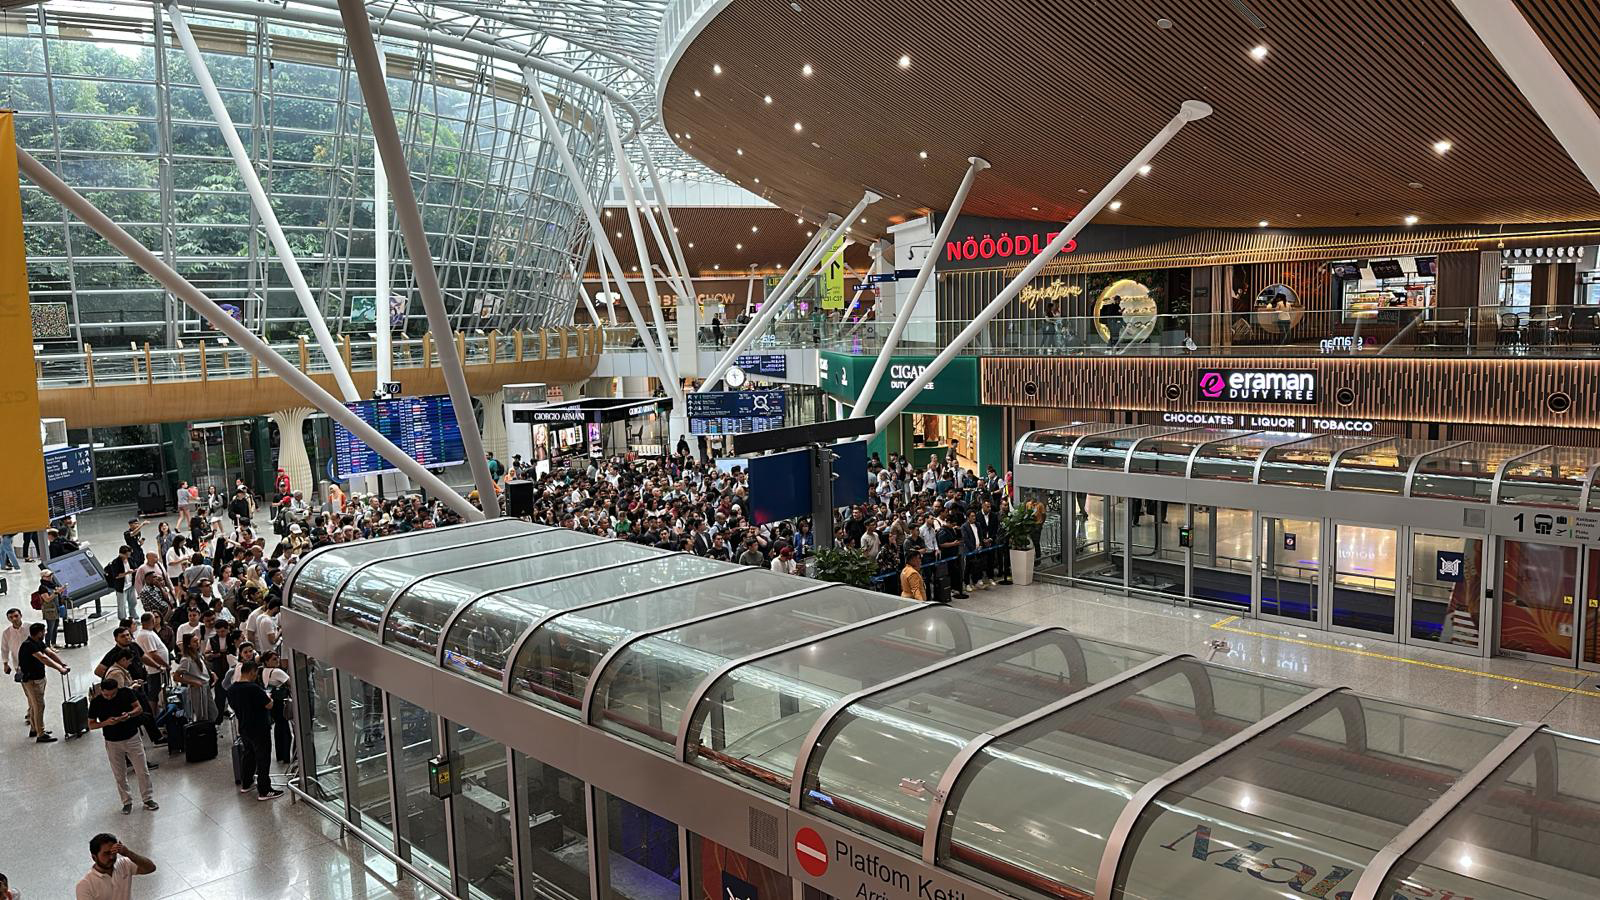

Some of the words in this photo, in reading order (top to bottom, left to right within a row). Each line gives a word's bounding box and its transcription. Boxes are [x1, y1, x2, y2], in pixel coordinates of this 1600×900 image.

[1229, 372, 1314, 390] eraman
[1229, 389, 1269, 399] DUTY
[1274, 390, 1314, 400] FREE
[534, 412, 561, 421] GIORGIO
[561, 412, 585, 421] ARMANI
[1163, 413, 1234, 425] CHOCOLATES
[1251, 417, 1295, 428] LIQUOR
[1313, 419, 1373, 432] TOBACCO
[1513, 513, 1524, 532] 1
[835, 840, 910, 893] Platfom
